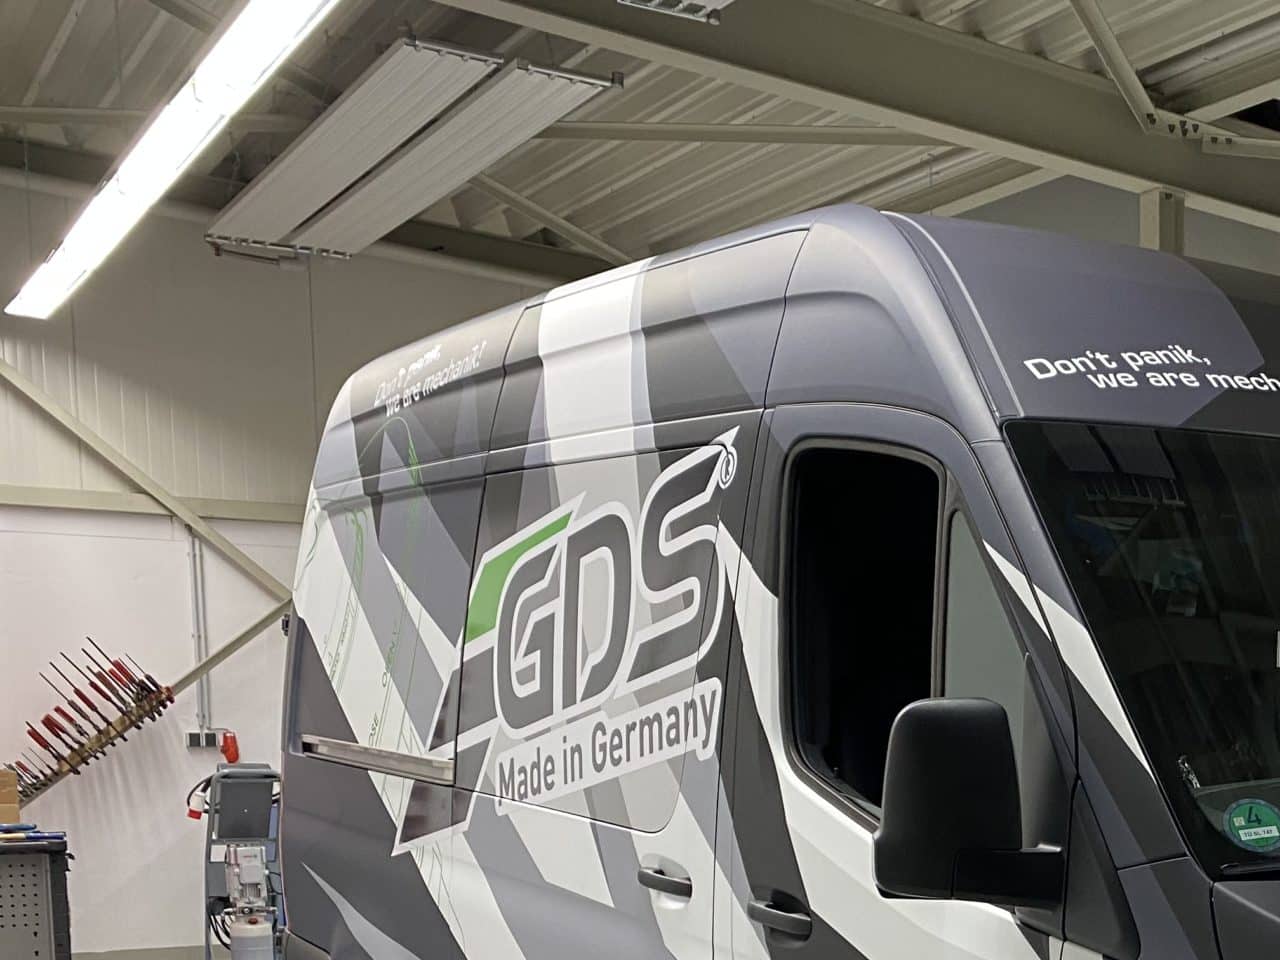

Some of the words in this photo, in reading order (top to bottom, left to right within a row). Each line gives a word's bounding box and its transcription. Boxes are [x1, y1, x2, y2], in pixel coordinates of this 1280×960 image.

[1024, 350, 1117, 380] Don't
[1121, 345, 1212, 371] panik,
[1088, 372, 1139, 389] we
[1146, 370, 1200, 387] are
[494, 446, 730, 733] GDS
[499, 746, 556, 807] Made
[563, 735, 583, 785] in
[592, 689, 717, 773] Germany
[1247, 805, 1262, 825] 4
